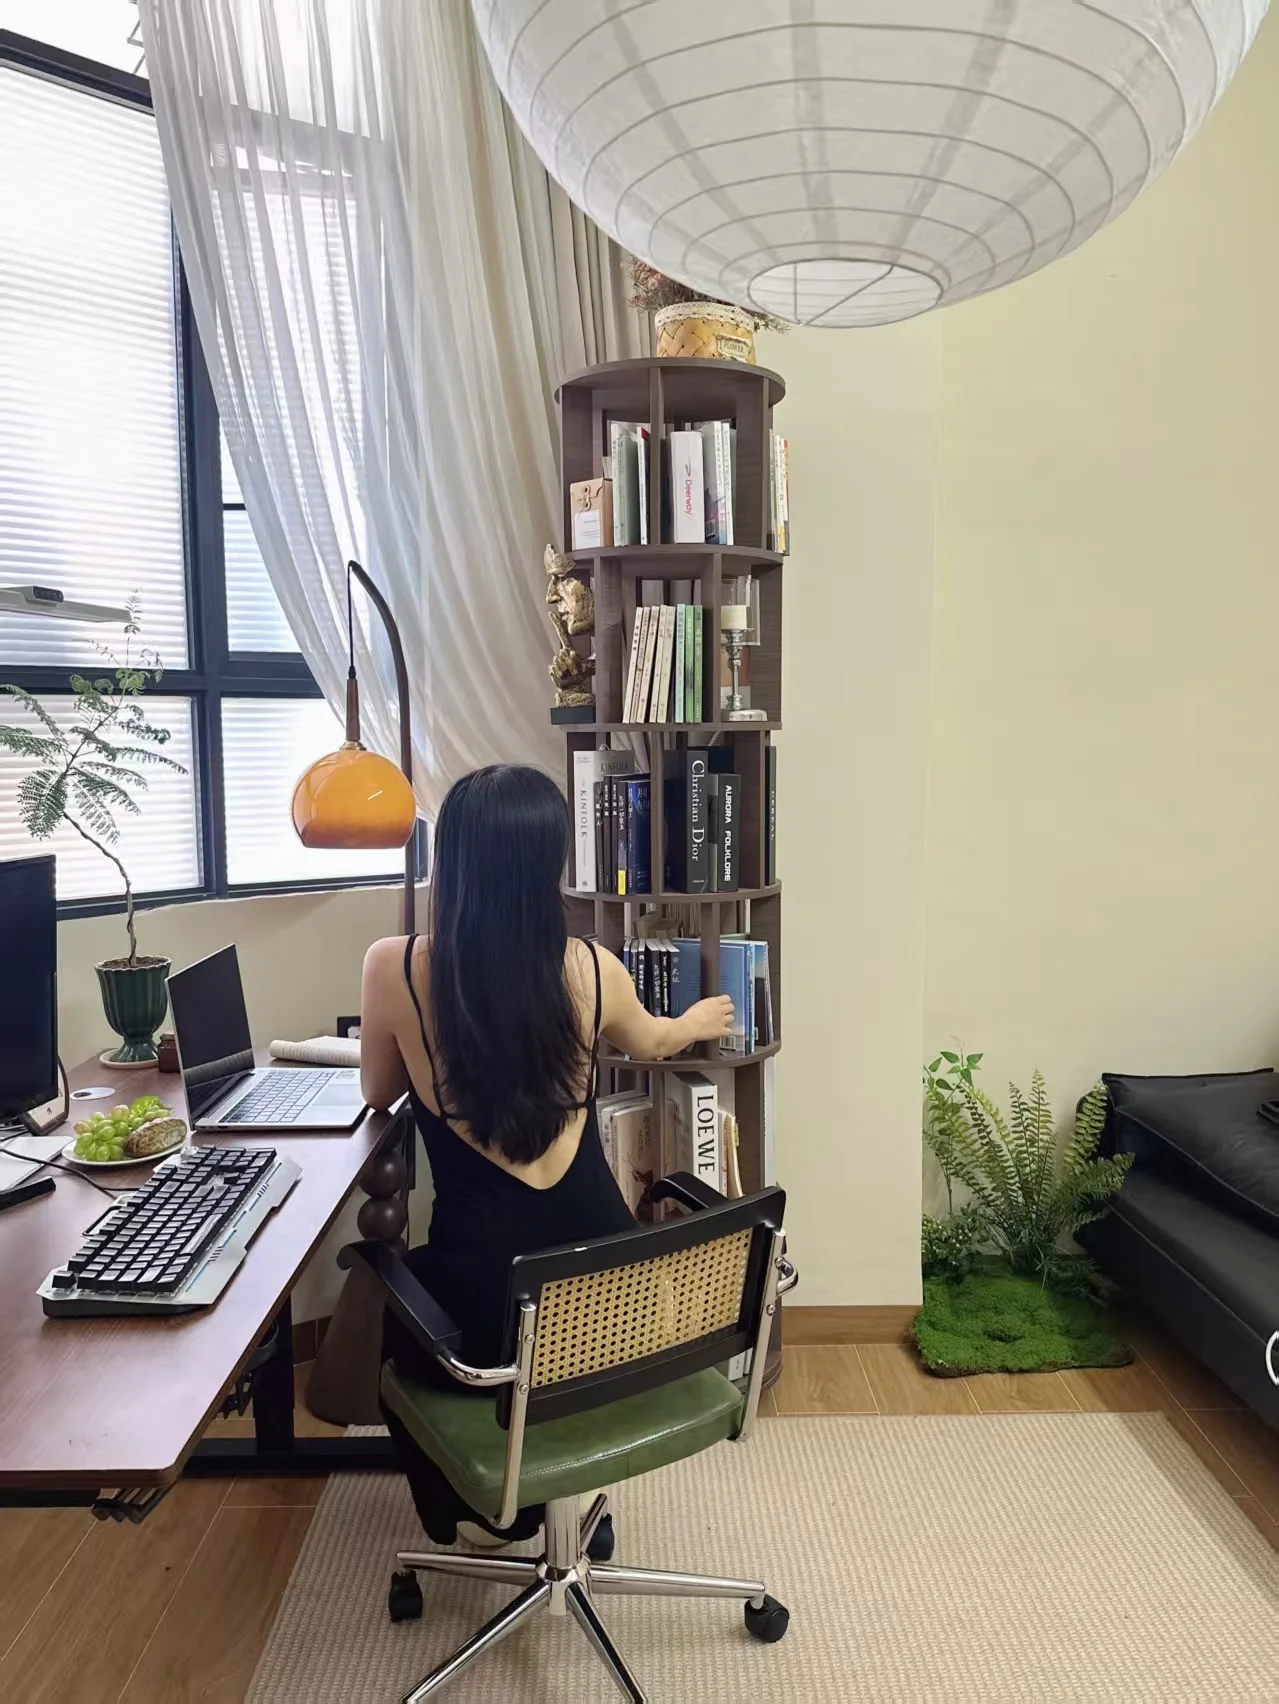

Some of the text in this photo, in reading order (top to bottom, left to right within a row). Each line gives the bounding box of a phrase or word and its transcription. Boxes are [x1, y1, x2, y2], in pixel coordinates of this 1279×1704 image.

[723, 340, 744, 354] FLOWER
[580, 790, 588, 837] KINFOLK
[691, 759, 705, 861] Christian Dior
[724, 784, 732, 824] AURORA
[697, 1095, 715, 1175] LOEWE
